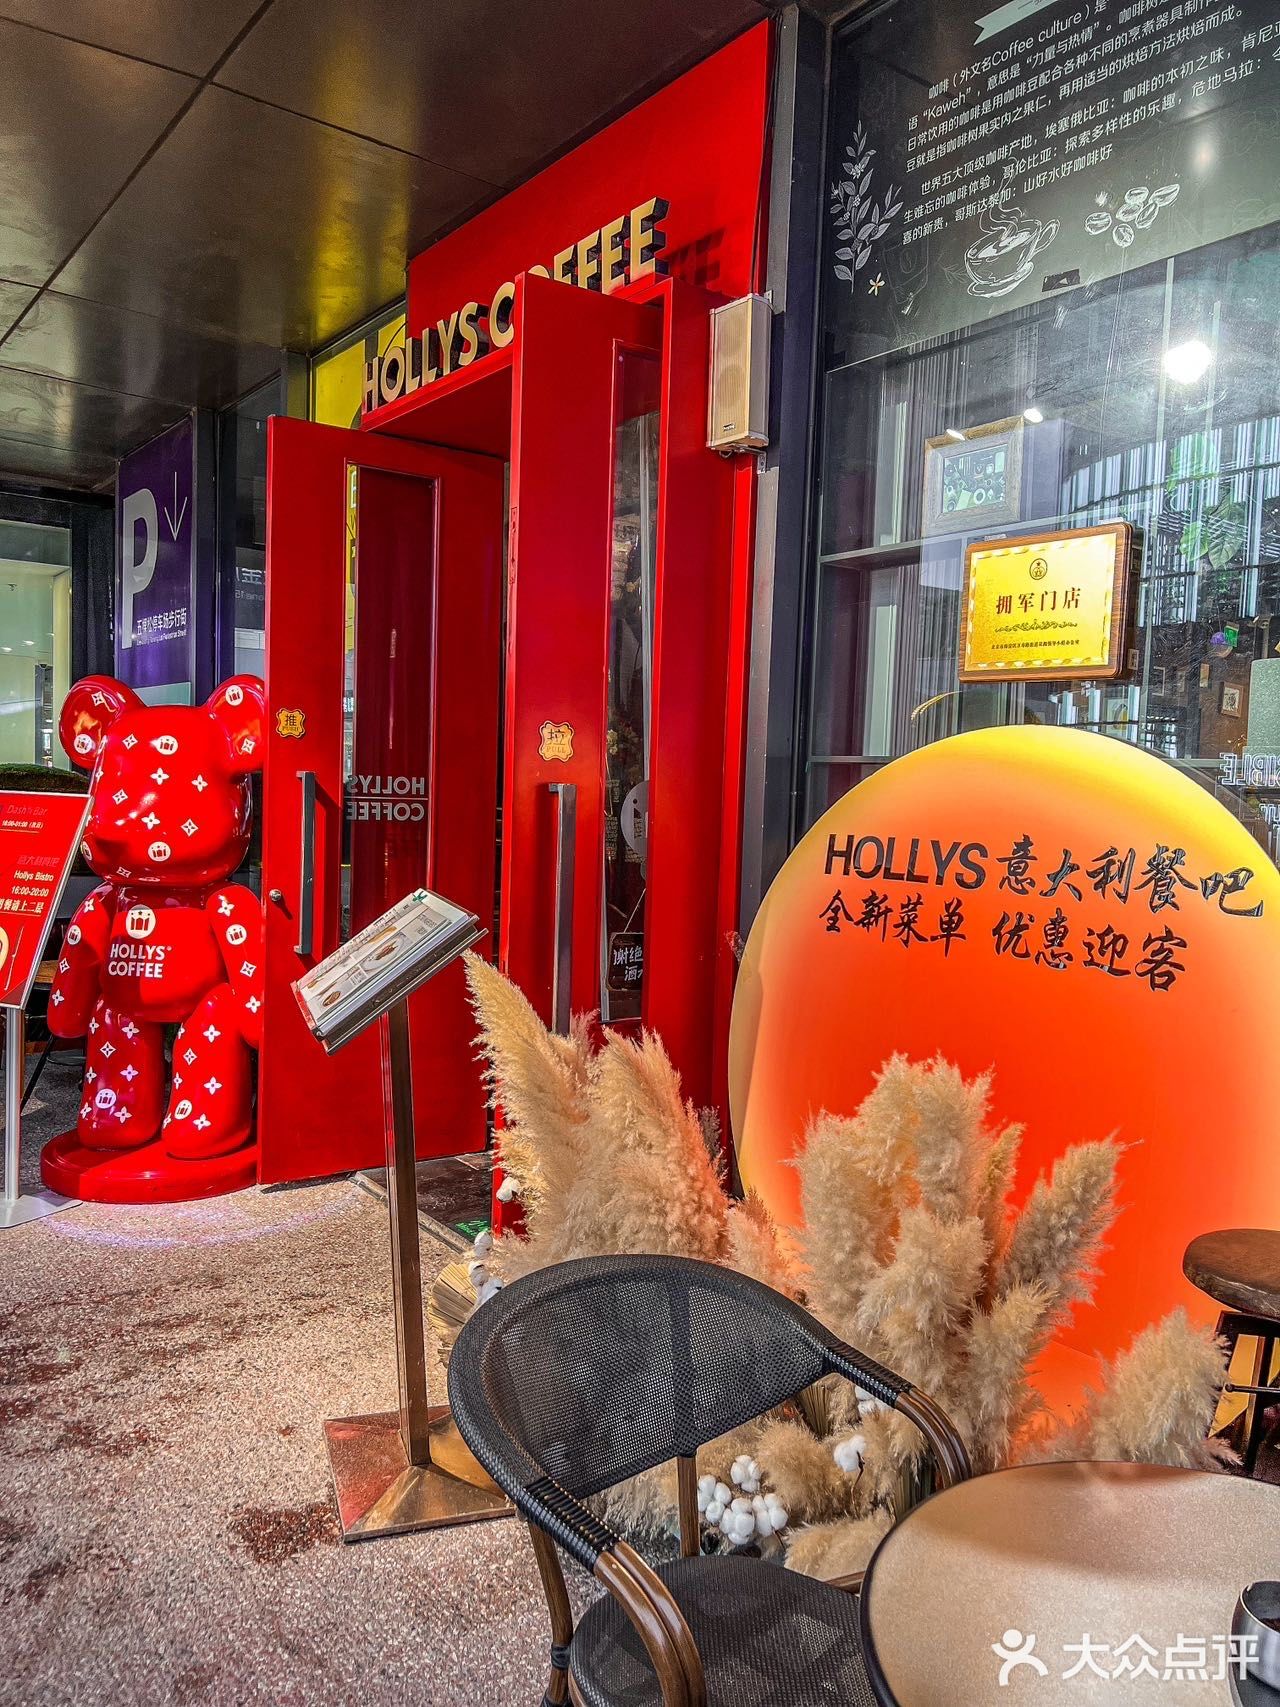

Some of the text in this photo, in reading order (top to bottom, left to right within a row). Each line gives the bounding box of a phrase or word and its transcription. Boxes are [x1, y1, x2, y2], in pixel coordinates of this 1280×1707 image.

[362, 197, 668, 413] HOLLYS CFFEE
[121, 488, 159, 650] P
[995, 587, 1081, 615] 拥军门店
[285, 714, 298, 727] 推
[546, 728, 566, 746] 拉
[13, 870, 54, 882] Hollys Bistro
[824, 833, 1266, 918] HOLLYS 意大利餐吧
[11, 886, 49, 897] 16:00-20:00
[818, 888, 1188, 993] 全新菜单 优惠迎客
[110, 943, 165, 961] HOLLYS
[613, 945, 644, 965] 谢绝
[108, 961, 164, 978] COFFEE
